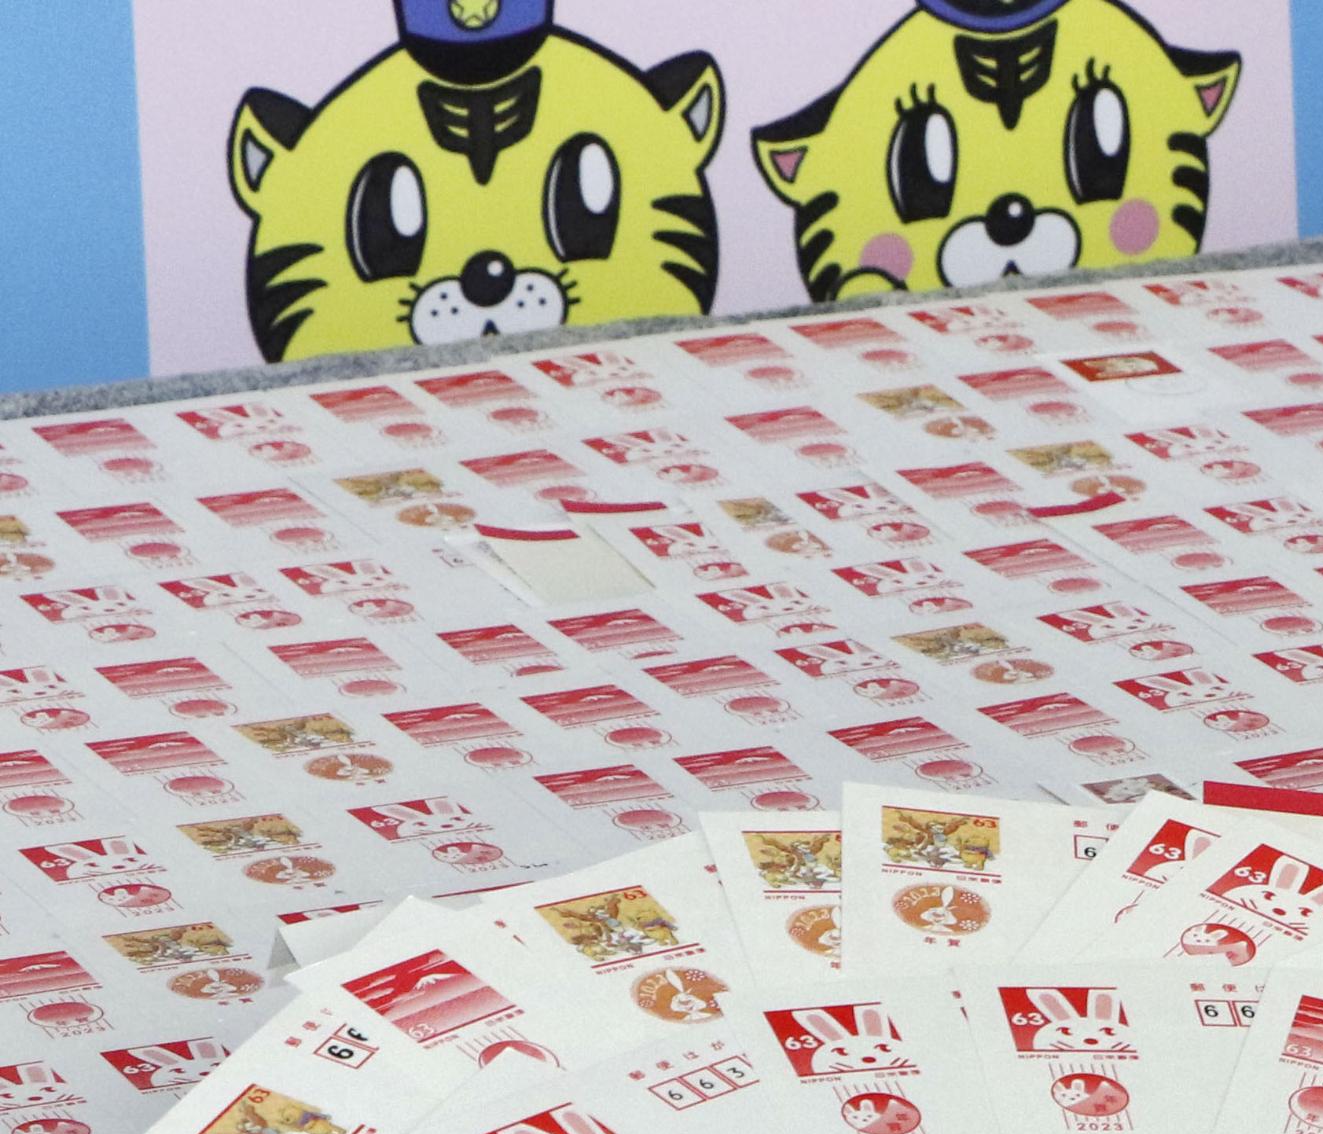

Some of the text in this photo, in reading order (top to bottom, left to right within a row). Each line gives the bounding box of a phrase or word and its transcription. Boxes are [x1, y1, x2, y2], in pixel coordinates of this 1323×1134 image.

[973, 819, 997, 829] 63
[1084, 847, 1097, 859] 6
[1149, 843, 1181, 859] 63
[881, 868, 923, 877] NIPPON
[1234, 866, 1267, 884] 63
[1121, 873, 1161, 890] NIPPON
[623, 888, 648, 901] 63
[1200, 892, 1235, 912] NIPPON
[1011, 1012, 1045, 1026] 63
[1204, 1004, 1256, 1019] 66
[407, 1022, 435, 1040] 63
[784, 1035, 819, 1050] 63
[1285, 1043, 1312, 1058] 63
[123, 1064, 156, 1076] 63
[1278, 1057, 1320, 1071] NIPPON
[668, 1064, 745, 1102] 663
[248, 1088, 270, 1104] 63
[1077, 1123, 1123, 1131] 2023
